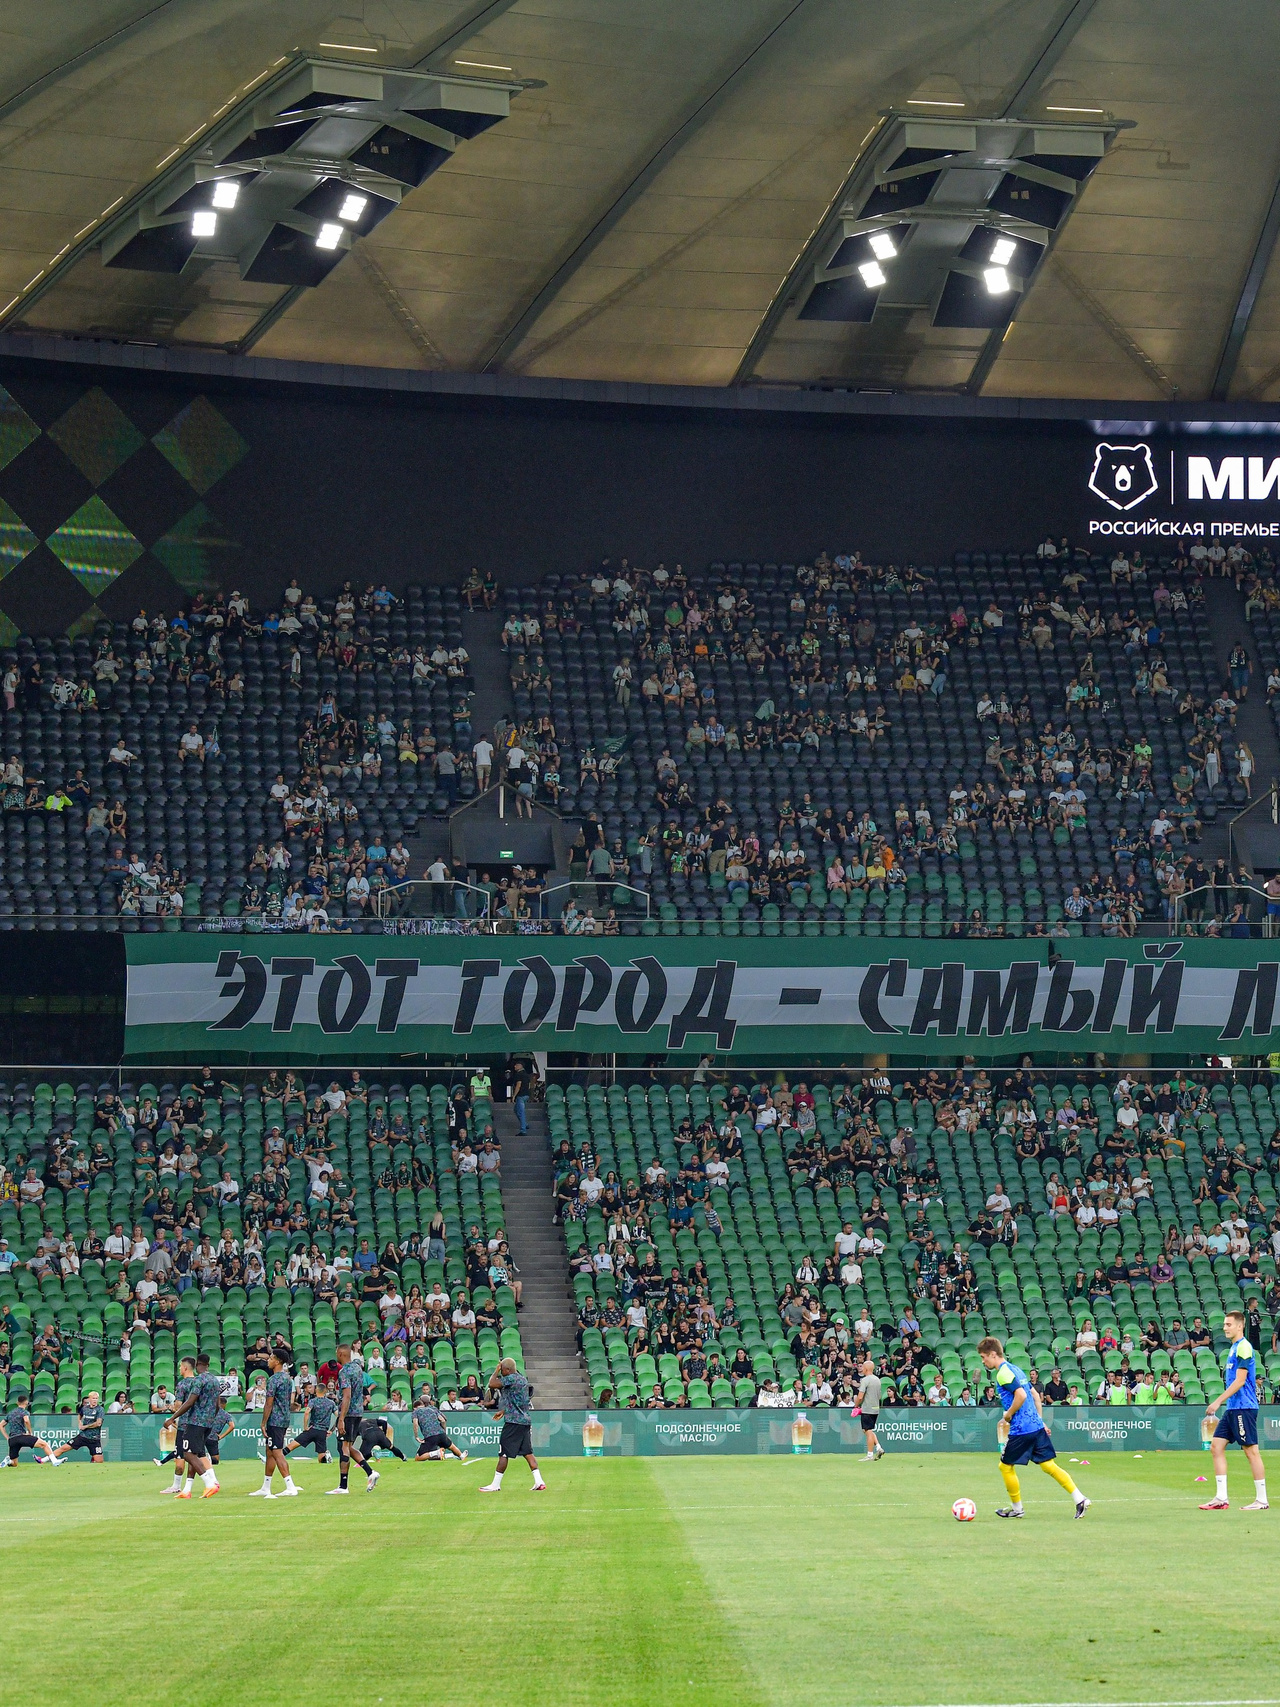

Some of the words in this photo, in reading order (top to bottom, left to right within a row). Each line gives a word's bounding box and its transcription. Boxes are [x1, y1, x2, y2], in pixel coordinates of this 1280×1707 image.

[1089, 518, 1204, 536] РОССИЙСКАЯ
[206, 950, 420, 1033] ЭТОТ
[451, 954, 738, 1051] ГОРОД
[857, 940, 1187, 1036] САМЫЙ
[656, 1424, 741, 1434] ПОДСОЛНЕЧНОЕ
[1068, 1421, 1152, 1430] ПОДСОЛНЕЧНОЕ
[446, 1426, 503, 1436] ПОДСОЛНЕ
[1092, 1430, 1128, 1439] МАСЛО
[470, 1436, 500, 1444] МАСЛ
[679, 1433, 717, 1442] МАСЛО
[887, 1432, 924, 1441] МАСЛО
